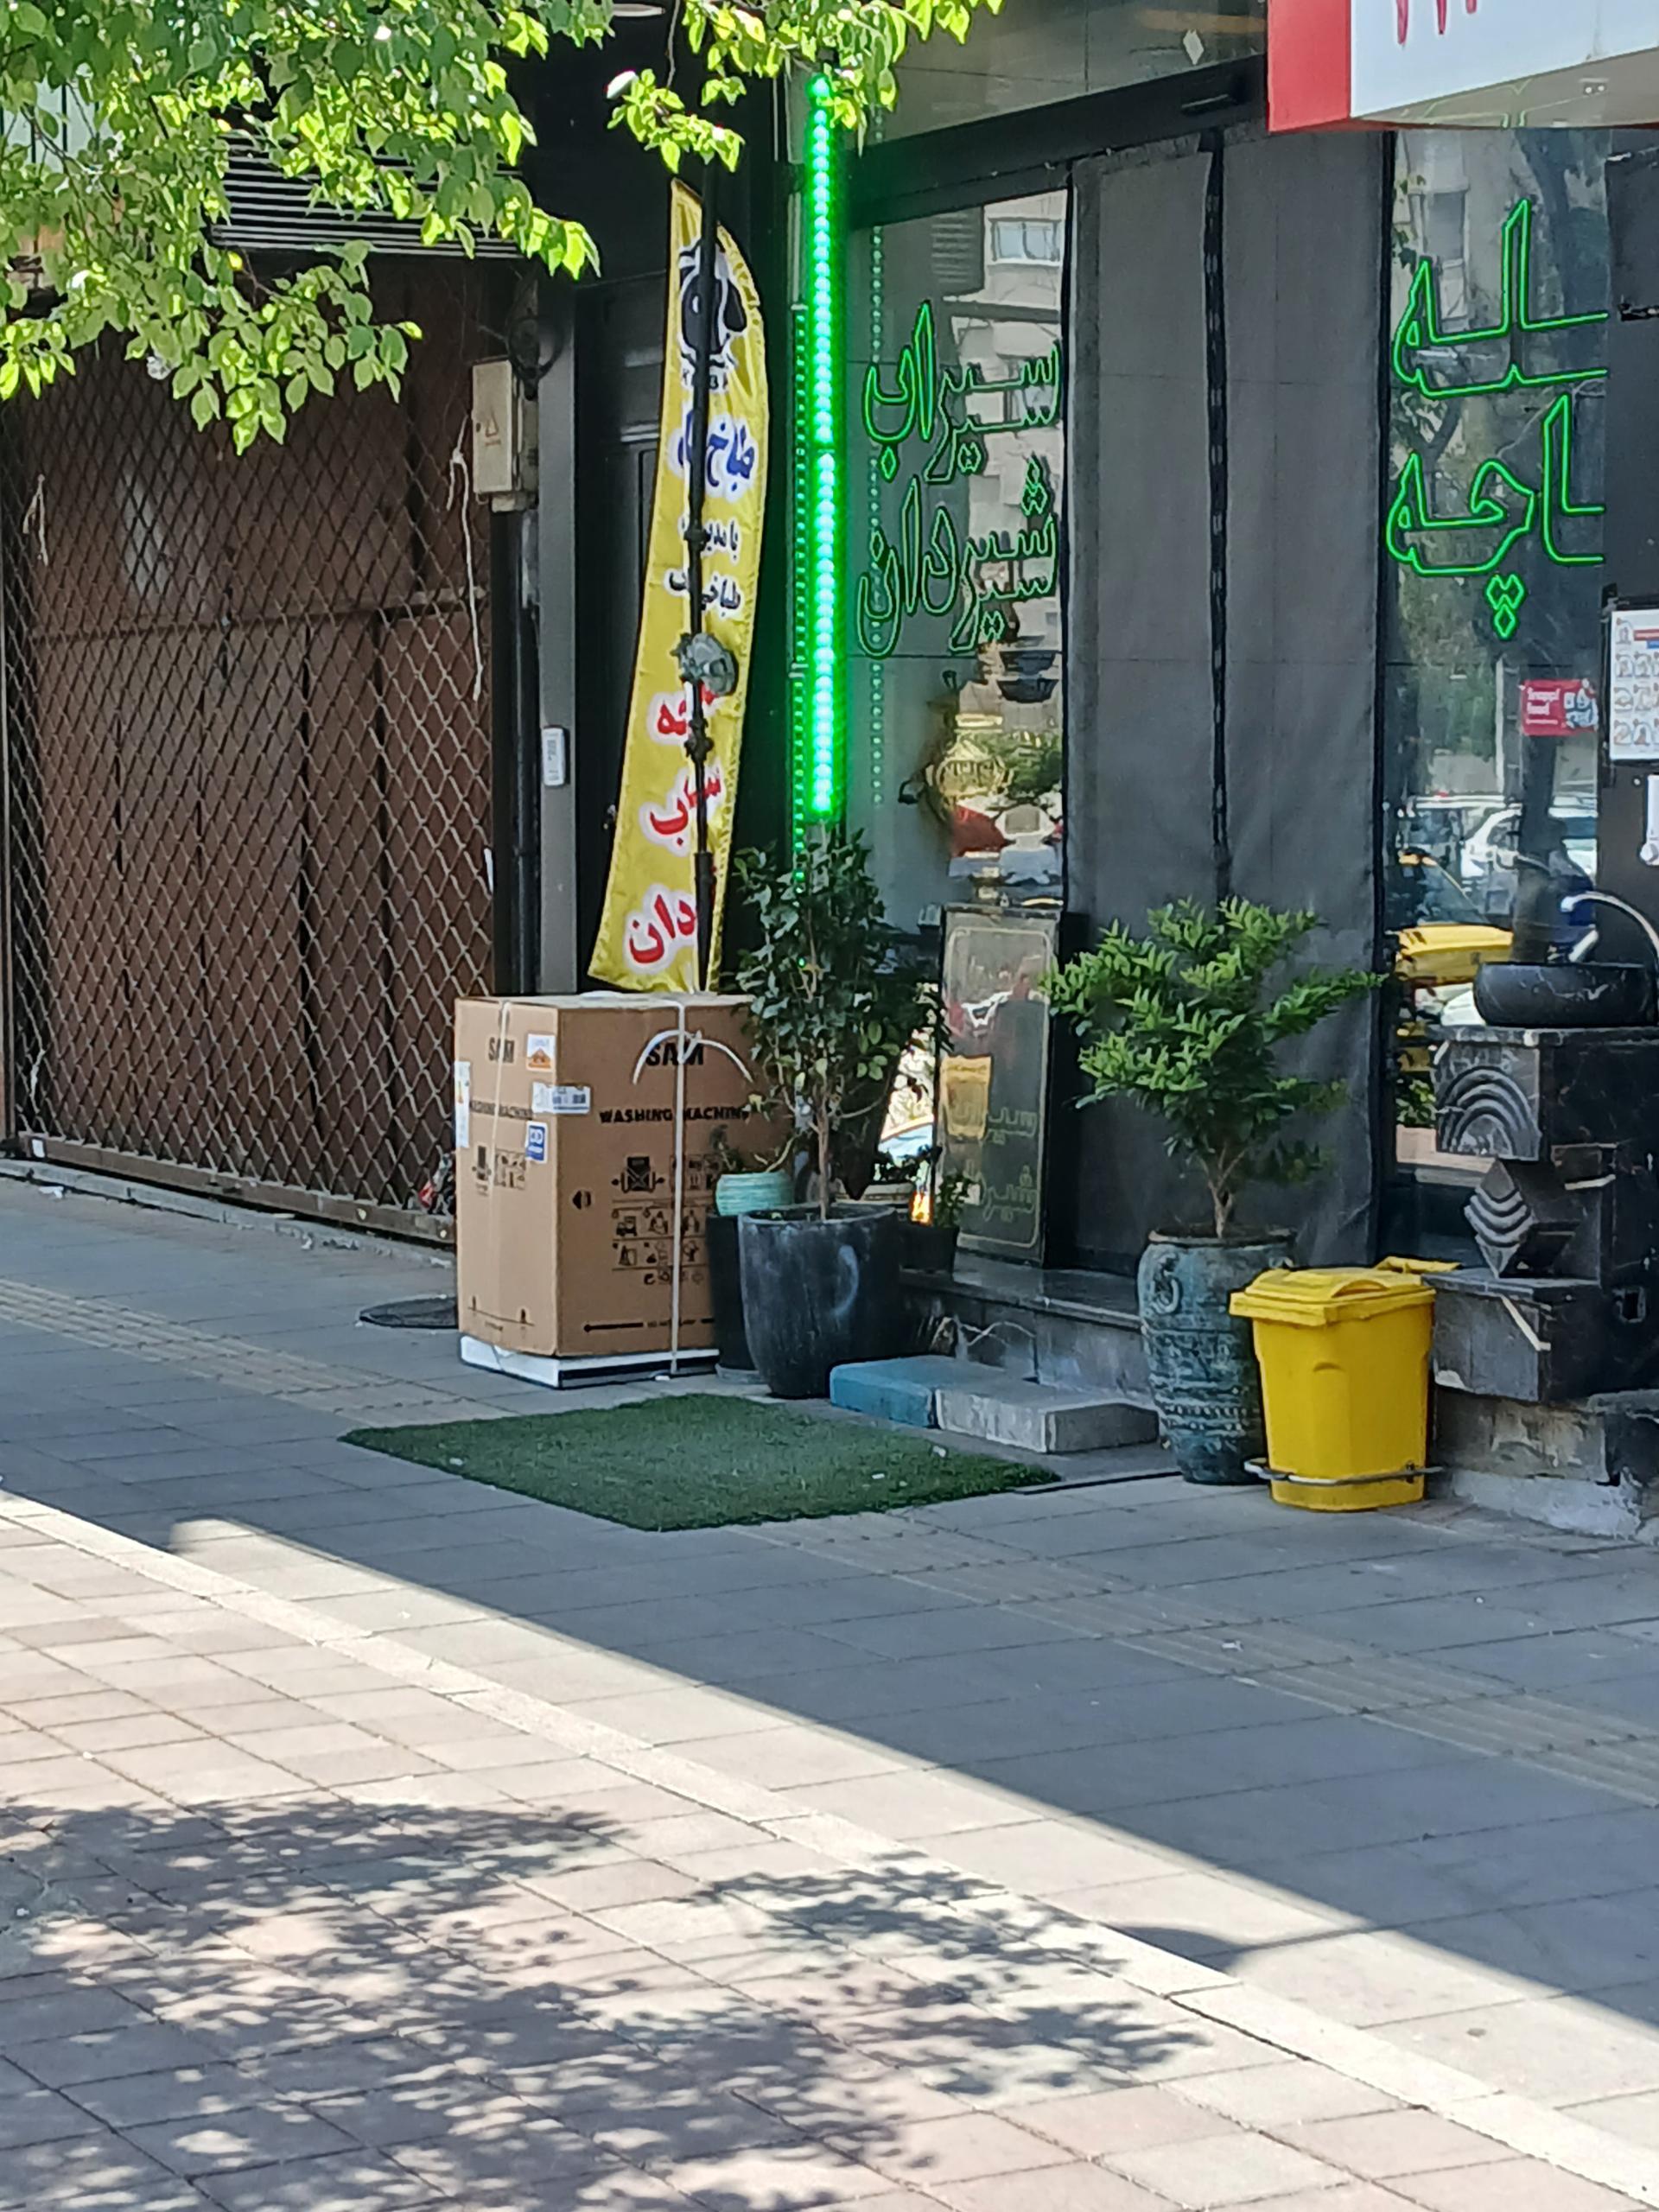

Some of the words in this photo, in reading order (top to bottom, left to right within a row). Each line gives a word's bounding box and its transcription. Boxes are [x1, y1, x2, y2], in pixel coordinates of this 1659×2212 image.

[861, 301, 1062, 484] سیراب
[856, 453, 1059, 658] شیردان
[599, 1108, 673, 1124] WASHING
